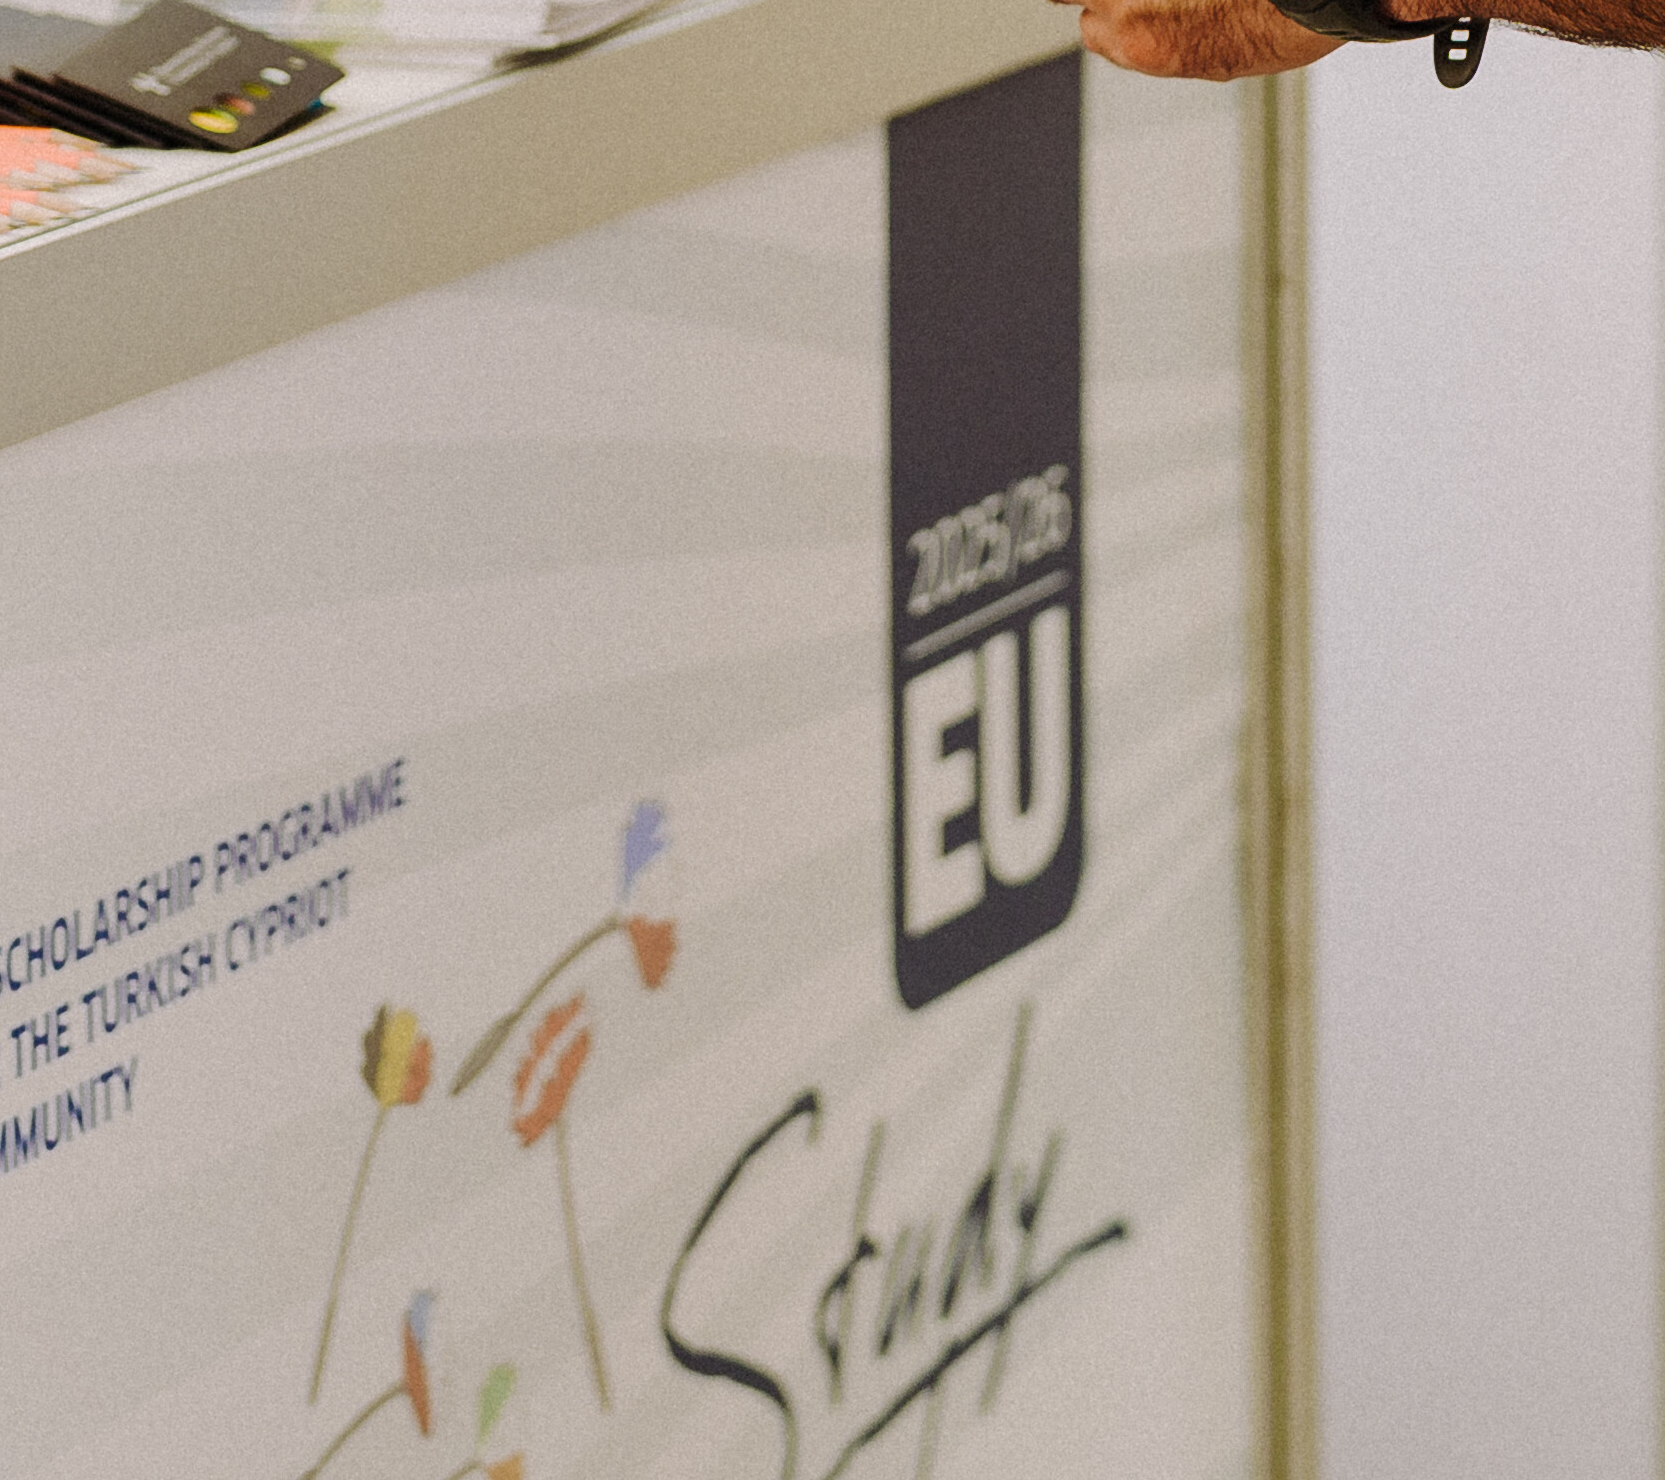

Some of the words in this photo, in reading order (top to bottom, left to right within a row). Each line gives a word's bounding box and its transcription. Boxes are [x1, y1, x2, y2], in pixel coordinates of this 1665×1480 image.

[906, 464, 1071, 618] 2025/26
[214, 756, 408, 895] PROGRAMME
[903, 603, 1070, 938] EU
[11, 1003, 70, 1080] THE
[82, 931, 218, 1043] TURKISH
[225, 866, 351, 971] CYPRIOT
[660, 998, 1127, 1480] Study
